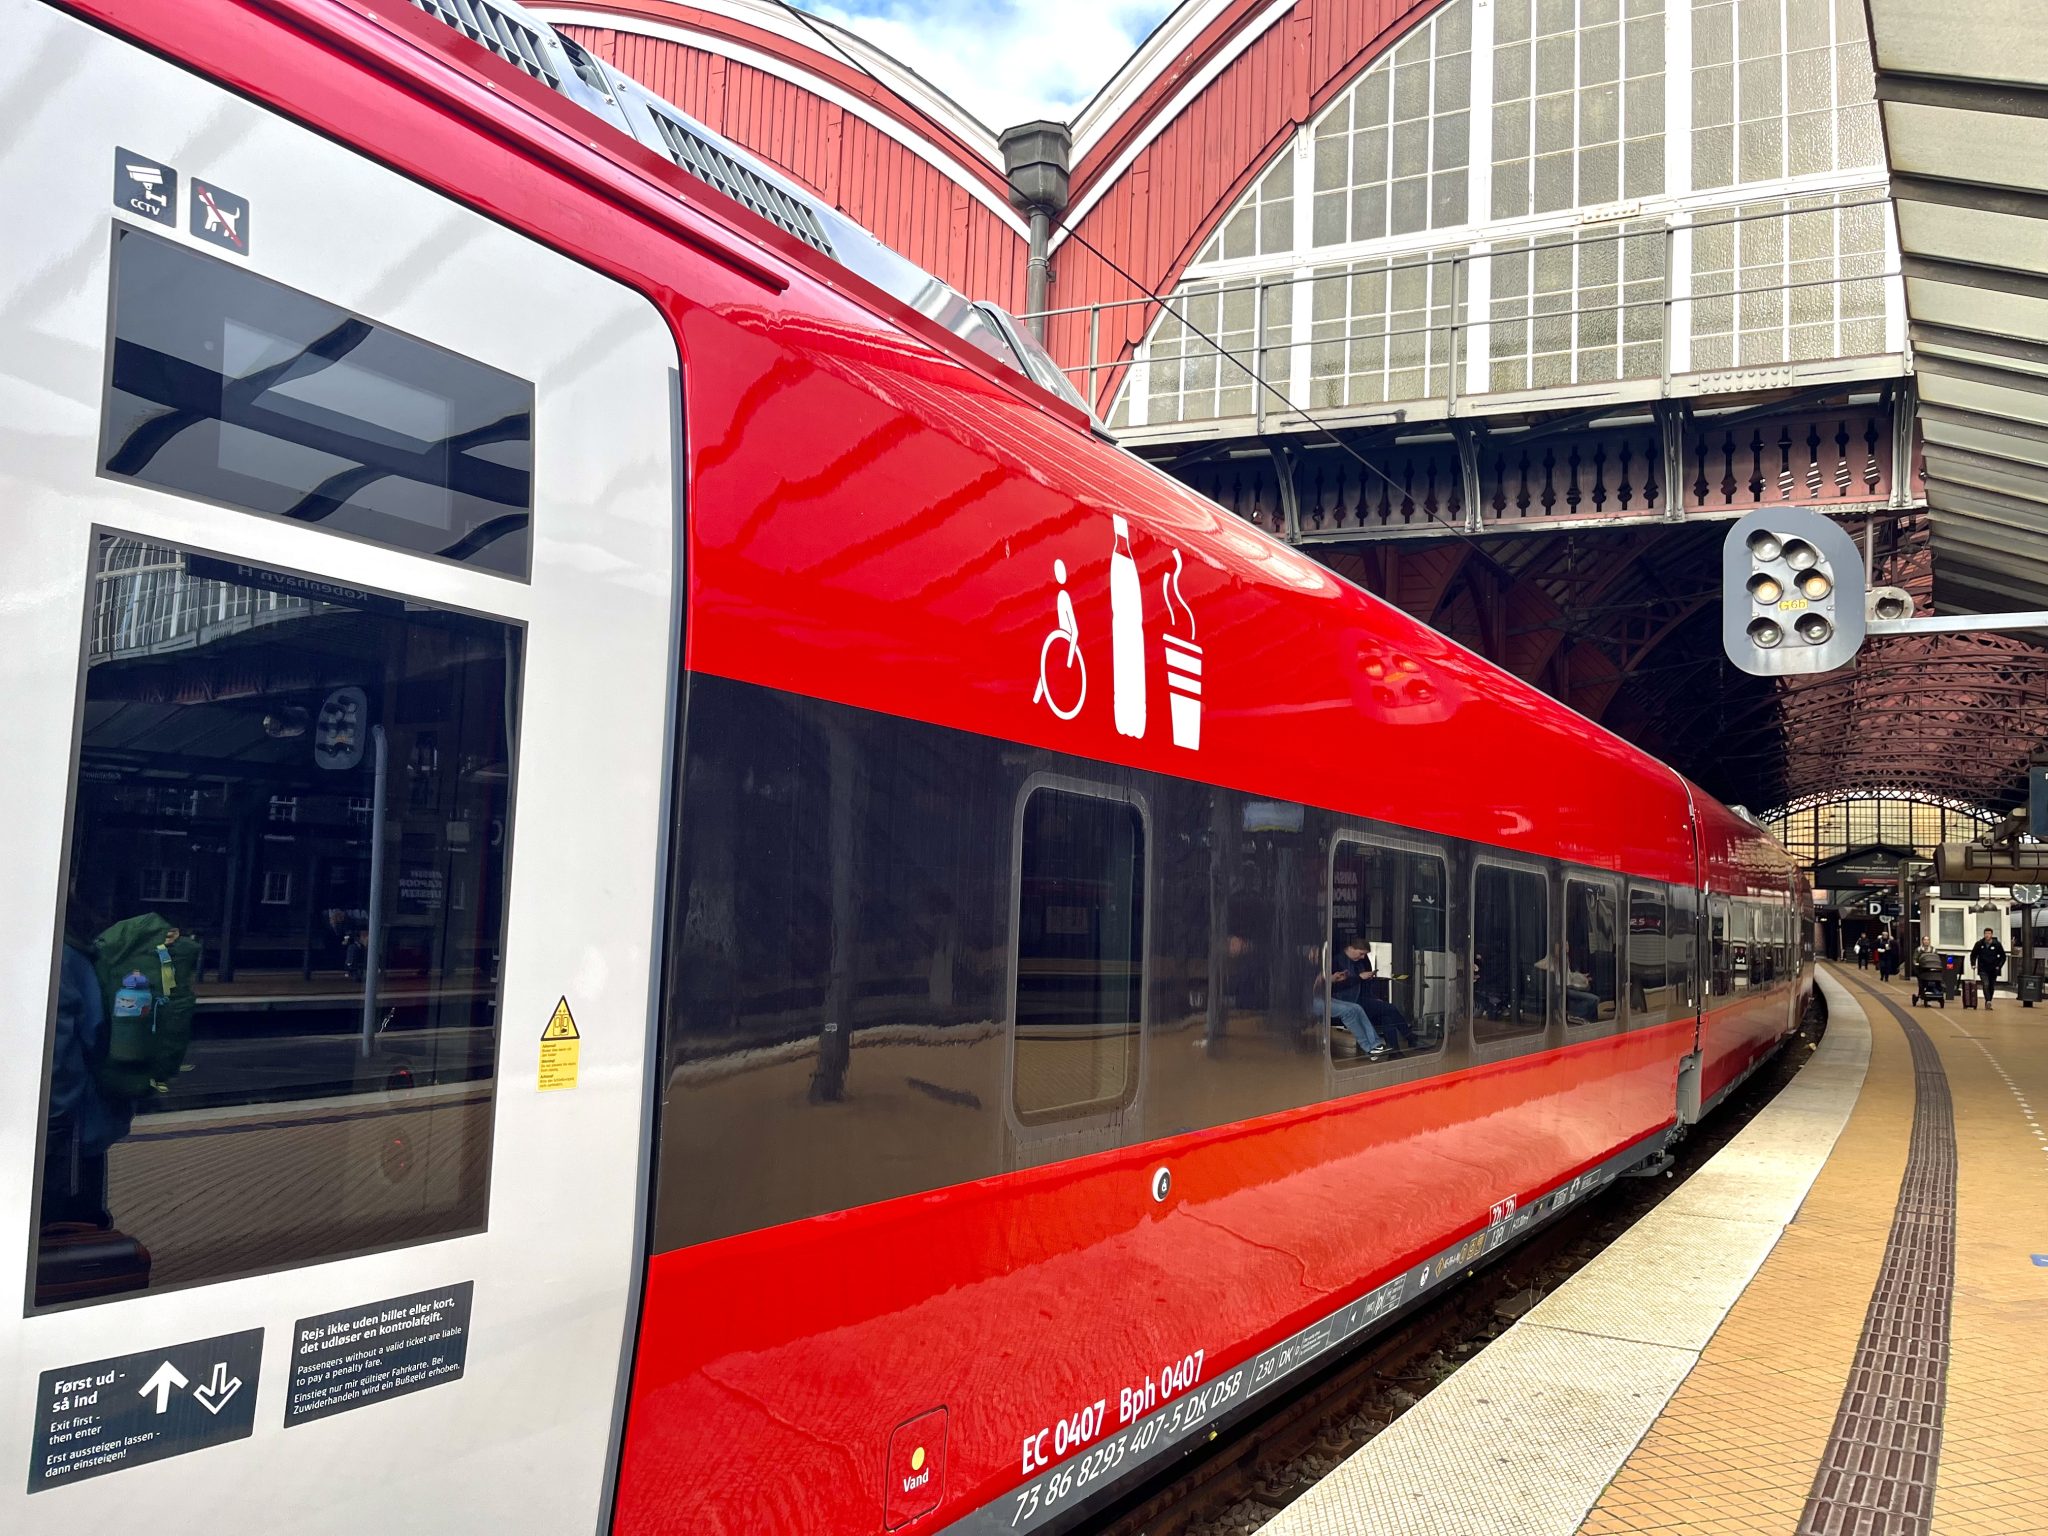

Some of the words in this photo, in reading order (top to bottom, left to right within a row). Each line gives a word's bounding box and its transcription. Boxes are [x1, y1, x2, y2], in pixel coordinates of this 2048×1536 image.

[130, 198, 160, 216] CCTV
[1869, 902, 1882, 915] D
[300, 1343, 319, 1355] det
[321, 1331, 362, 1350] udløser
[364, 1328, 377, 1339] en
[379, 1311, 444, 1336] kontrolafgift.
[301, 1328, 325, 1342] Rejs
[327, 1322, 351, 1336] ikke
[352, 1316, 379, 1330] uden
[381, 1308, 408, 1323] billet
[409, 1303, 432, 1316] eller
[433, 1297, 456, 1310] kort,
[297, 1357, 343, 1375] Passengers
[345, 1348, 378, 1362] without
[379, 1346, 384, 1354] a
[385, 1339, 405, 1353] valid
[406, 1335, 428, 1348] ticket
[429, 1331, 441, 1341] are
[442, 1326, 463, 1338] liable
[1255, 1357, 1276, 1382] 230
[1278, 1345, 1294, 1368] DK
[54, 1376, 93, 1395] Først
[96, 1370, 116, 1386] ud
[294, 1386, 328, 1404] Einstieg
[328, 1384, 343, 1394] nur
[360, 1371, 390, 1386] gültiger
[391, 1361, 430, 1378] Fahrkarte.
[432, 1355, 444, 1366] Bei
[296, 1378, 306, 1387] to
[307, 1373, 323, 1385] pay
[325, 1371, 331, 1379] a
[332, 1362, 364, 1379] penalty
[365, 1358, 383, 1369] fare.
[52, 1397, 70, 1413] så
[73, 1391, 98, 1408] ind
[293, 1390, 360, 1415] Zuwiderhandeln
[361, 1383, 380, 1396] wird
[381, 1380, 394, 1390] ein
[395, 1371, 427, 1387] Bußgeld
[428, 1363, 460, 1377] erhoben.
[50, 1421, 71, 1433] Exit
[72, 1416, 93, 1428] first
[1022, 1427, 1049, 1475] EC
[1054, 1398, 1105, 1456] 0407
[1119, 1375, 1156, 1425] Bph
[1161, 1348, 1204, 1399] 0407
[46, 1454, 67, 1466] Erst
[69, 1440, 122, 1461] aussteigen
[124, 1432, 154, 1446] lassen
[49, 1433, 73, 1446] then
[74, 1426, 102, 1439] enter
[1011, 1483, 1042, 1527] 73
[1044, 1464, 1075, 1506] 86
[1076, 1435, 1128, 1487] 8293
[1129, 1402, 1184, 1454] 407-5
[1183, 1387, 1212, 1425] DK
[1210, 1370, 1243, 1409] DSB
[45, 1465, 71, 1478] dann
[73, 1449, 127, 1471] einsteigen!
[902, 1468, 929, 1493] Vand
